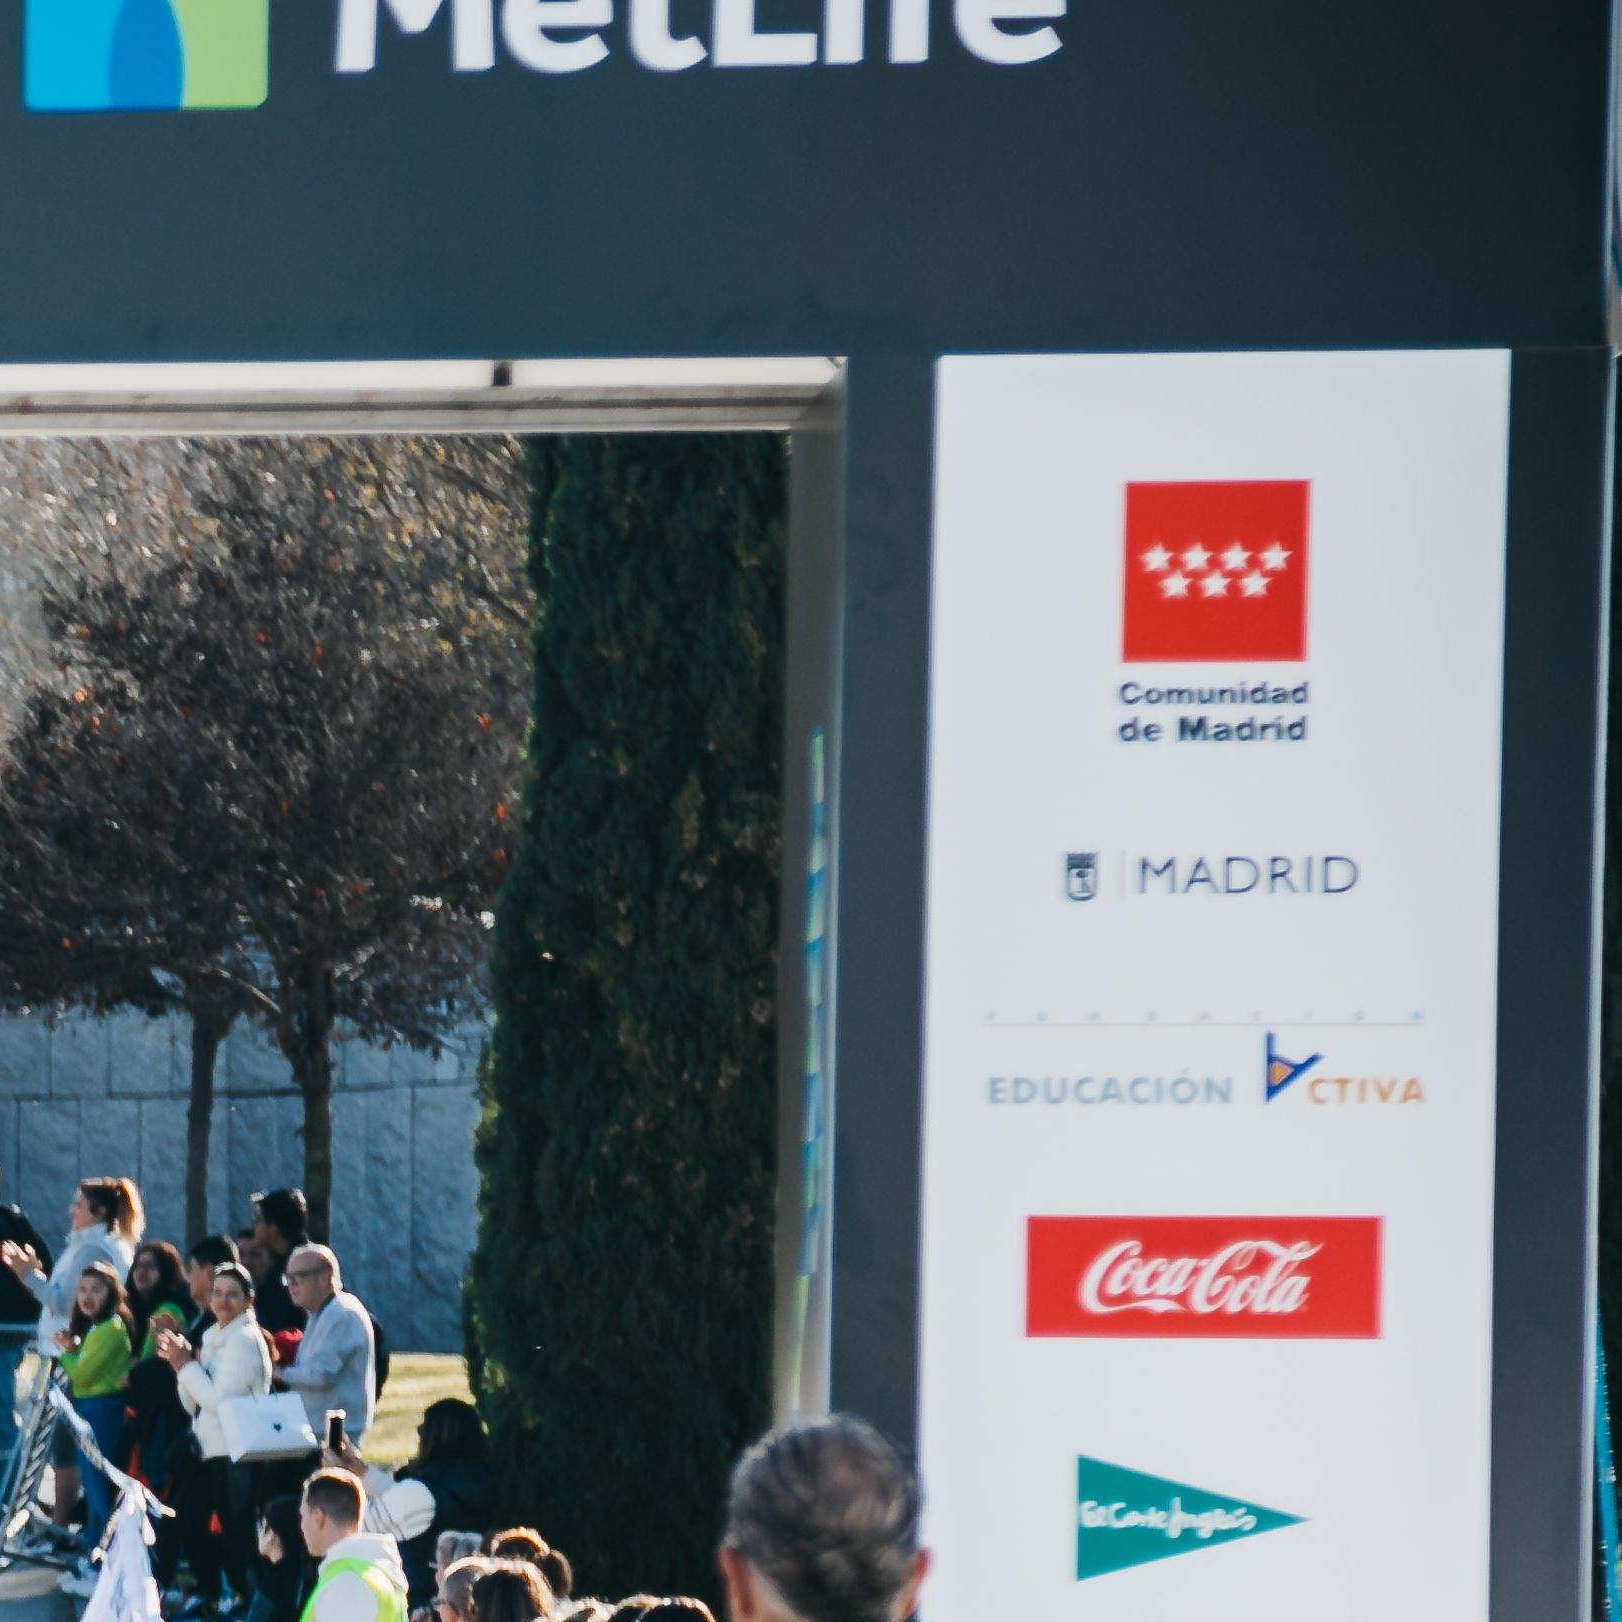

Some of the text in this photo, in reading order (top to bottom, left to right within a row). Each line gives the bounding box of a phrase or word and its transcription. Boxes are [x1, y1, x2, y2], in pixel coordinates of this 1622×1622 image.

[1118, 681, 1310, 706] Comunidad
[1119, 717, 1307, 742] de Madrid
[1139, 857, 1358, 894] MADRID
[987, 1069, 1233, 1105] EDUCACIÓN
[1080, 1239, 1324, 1316] Coca-Cola
